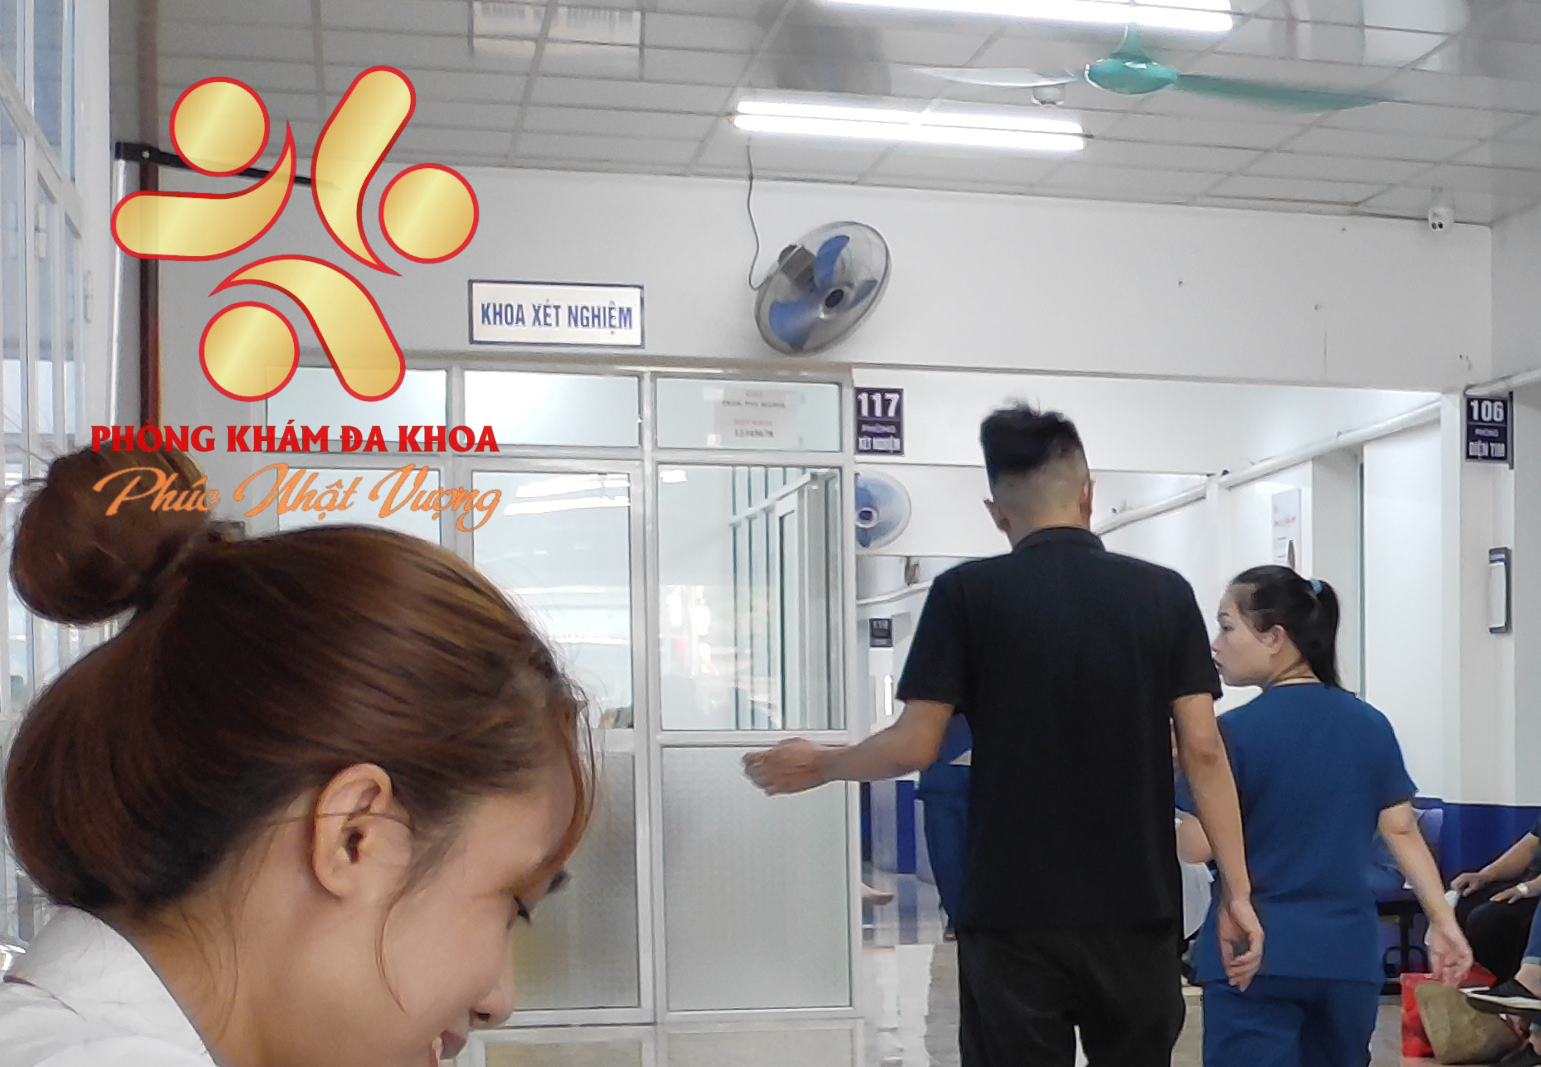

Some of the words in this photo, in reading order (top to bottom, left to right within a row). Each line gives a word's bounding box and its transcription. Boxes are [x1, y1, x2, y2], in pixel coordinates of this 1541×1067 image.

[481, 302, 525, 325] KHOA
[568, 301, 633, 335] NGHIỆM
[858, 392, 899, 417] 117
[1470, 399, 1505, 422] 106
